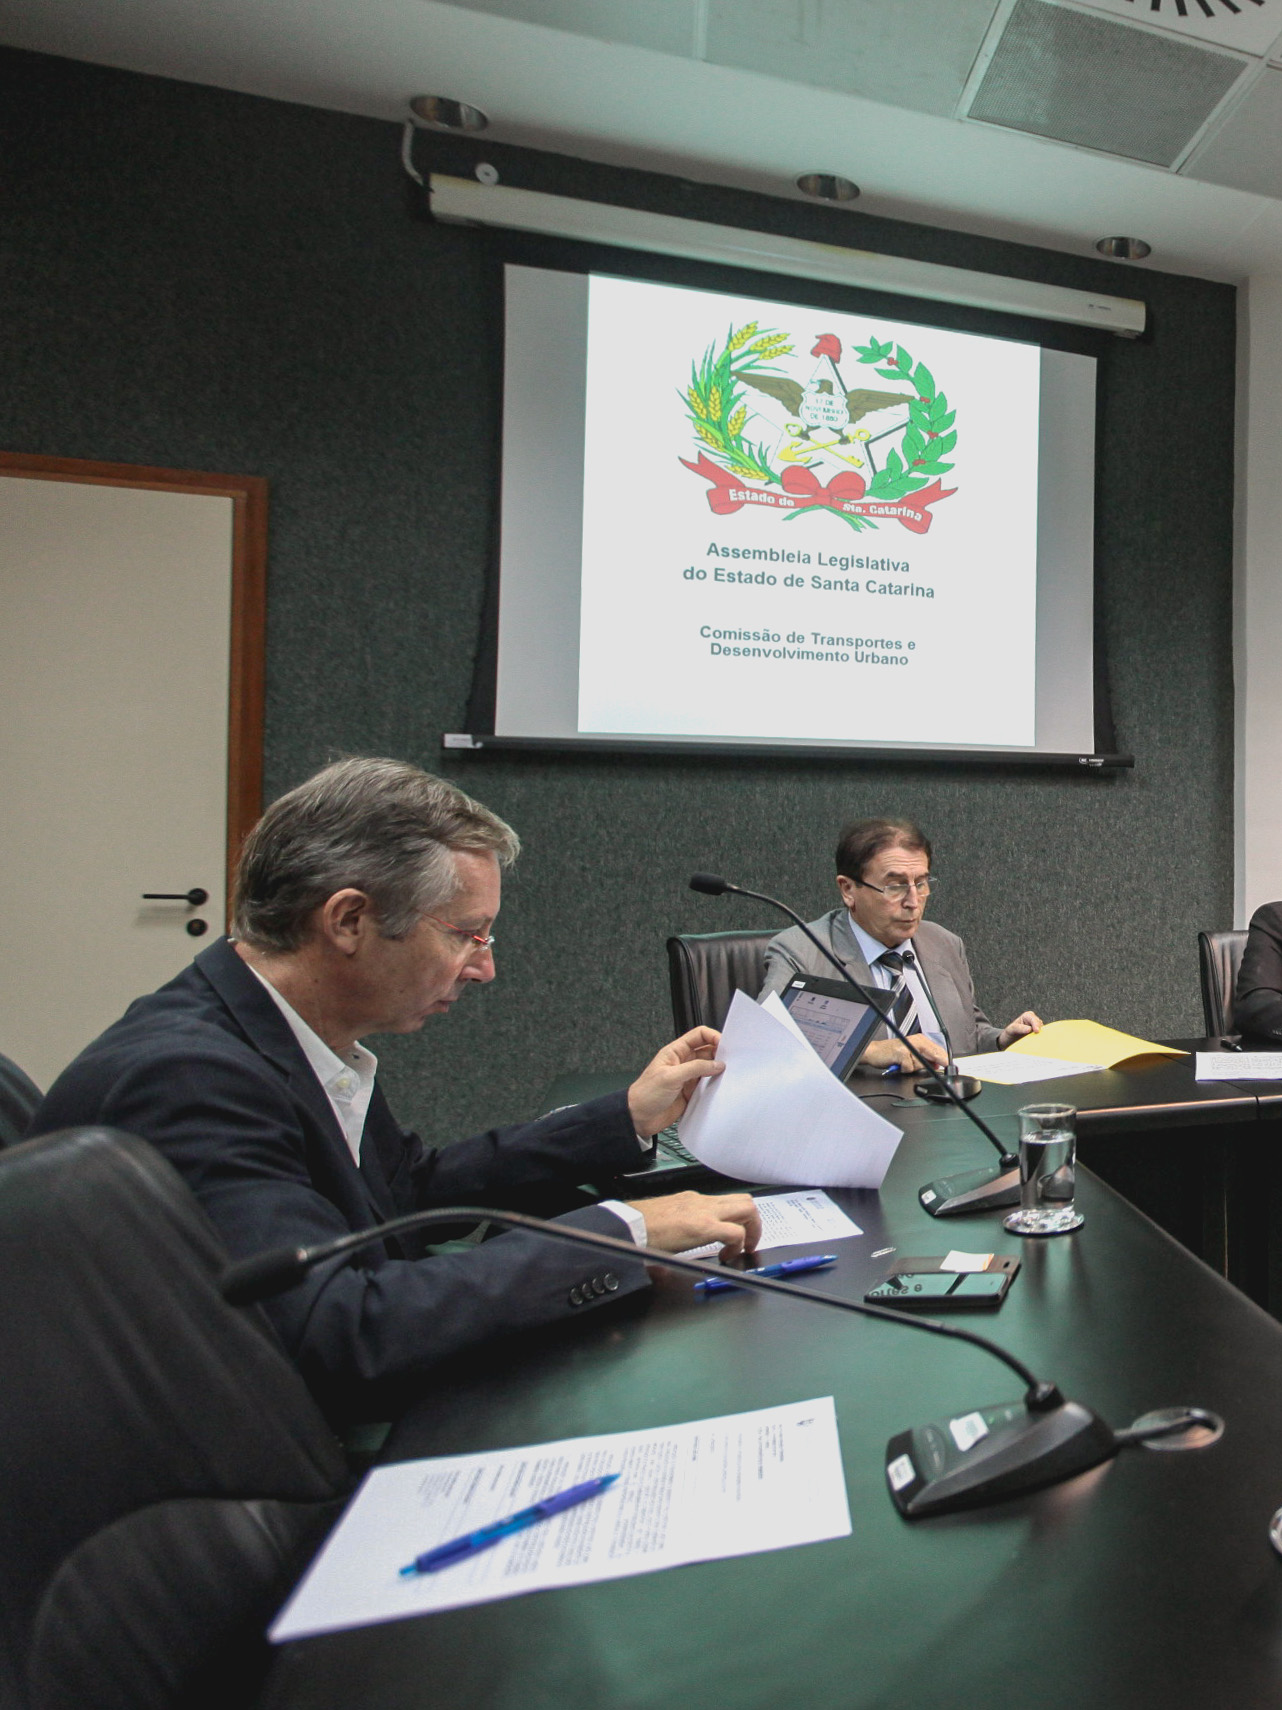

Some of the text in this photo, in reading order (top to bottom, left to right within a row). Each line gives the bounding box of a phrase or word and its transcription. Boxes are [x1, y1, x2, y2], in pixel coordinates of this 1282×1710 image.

[728, 488, 776, 504] Estado
[842, 502, 923, 522] Sta. Catarina
[706, 542, 910, 573] Assembleia Legislativa
[682, 566, 935, 599] do Estado de Santa Catarina
[699, 625, 916, 651] Comissão de Transportes e
[710, 642, 909, 666] Desenvolvimento Urbano
